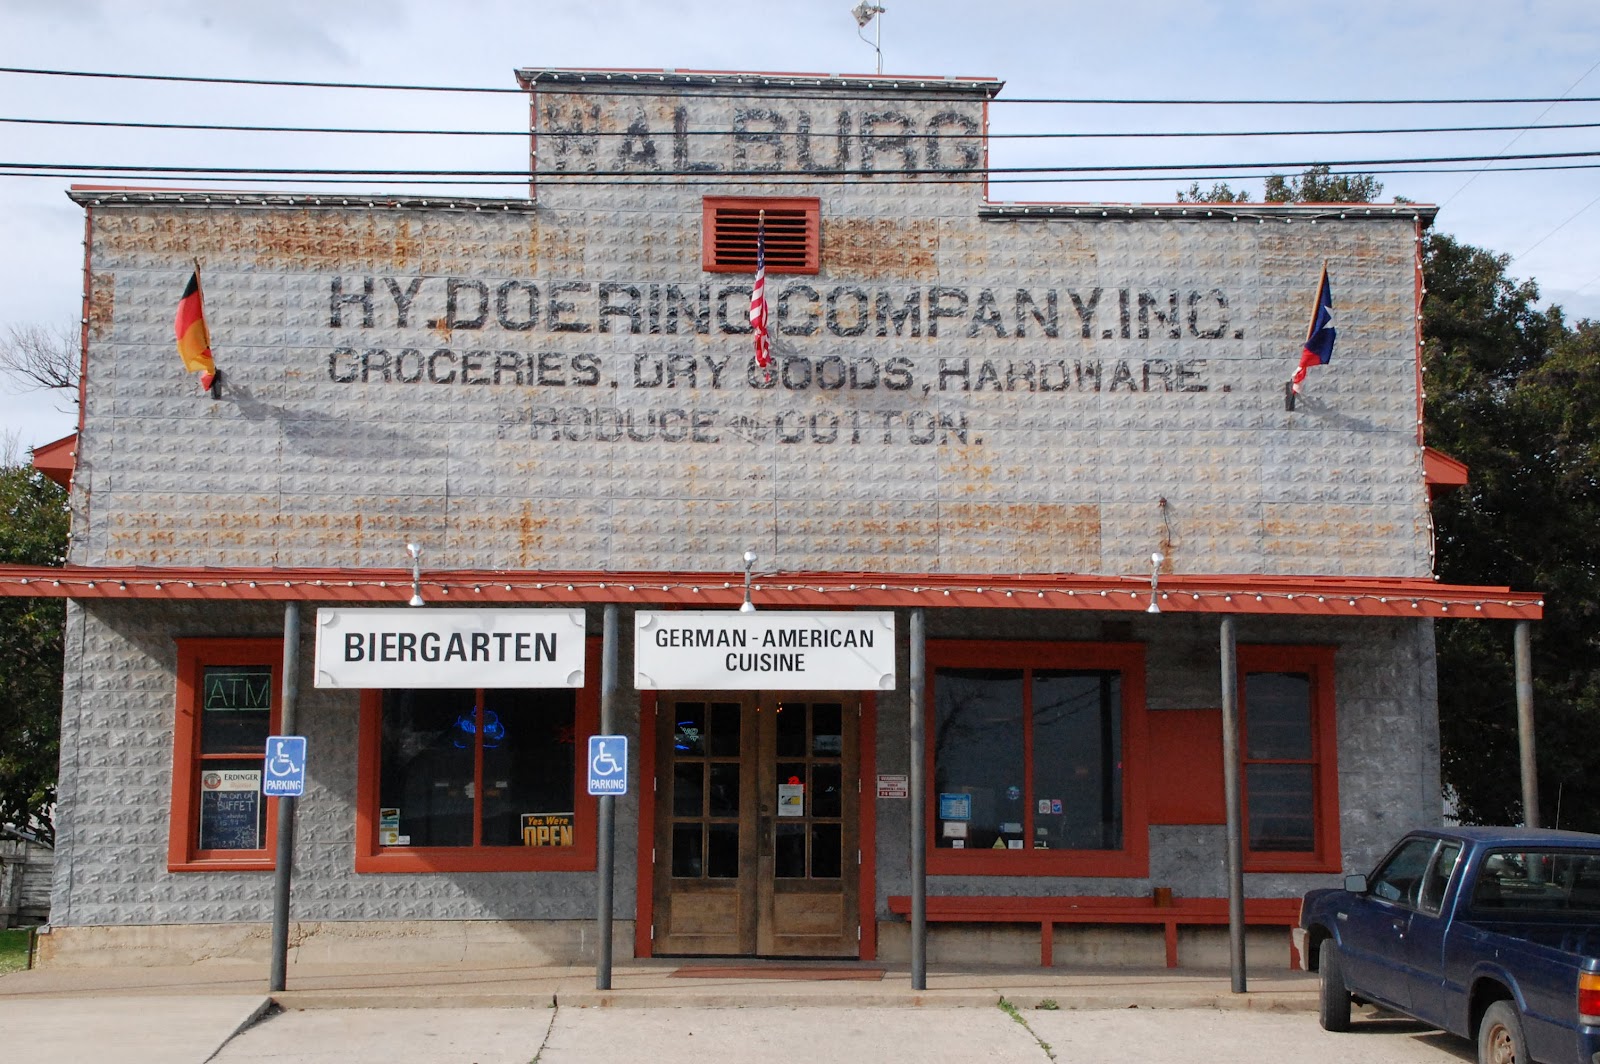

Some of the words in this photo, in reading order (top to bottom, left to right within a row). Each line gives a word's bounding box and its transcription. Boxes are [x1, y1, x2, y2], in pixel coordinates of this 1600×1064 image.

[446, 278, 756, 335] DOERING
[633, 353, 731, 388] DRY
[498, 405, 721, 443] PRODUCE
[344, 632, 558, 662] BIERGARTEN
[725, 653, 806, 672] CUISINE
[207, 678, 269, 707] ATM
[224, 773, 259, 782] ERDINGER
[266, 780, 301, 790] PARKING
[591, 779, 624, 790] PARKING
[216, 800, 254, 812] BUFFET
[524, 825, 573, 847] OPEN
